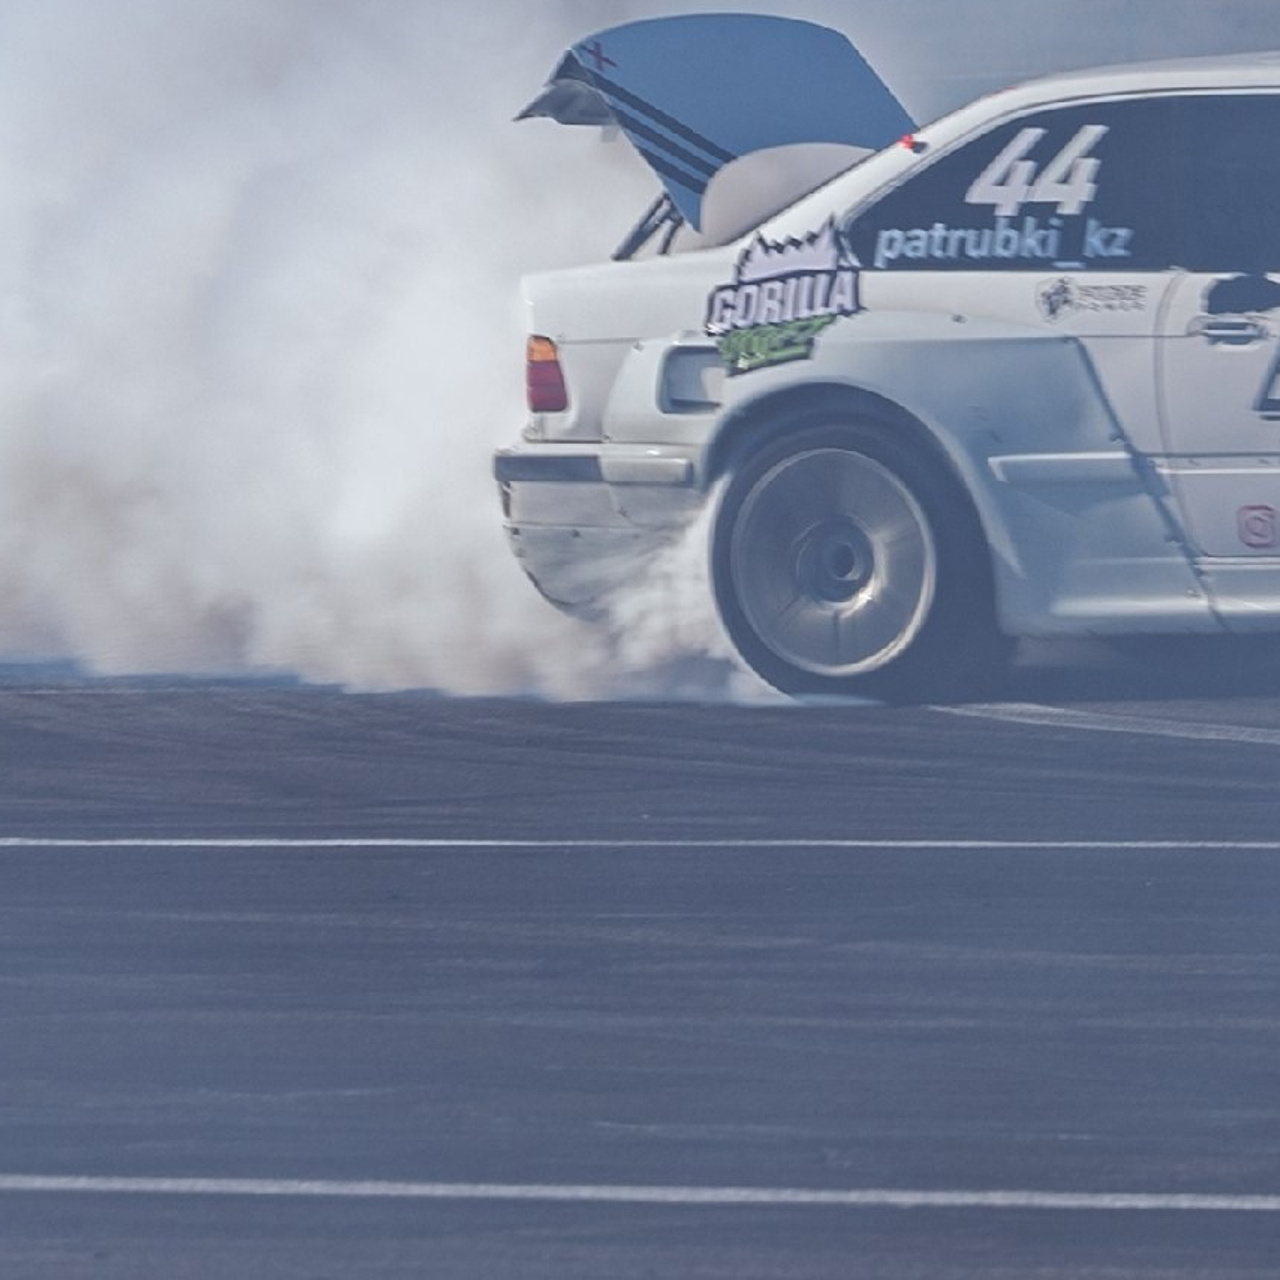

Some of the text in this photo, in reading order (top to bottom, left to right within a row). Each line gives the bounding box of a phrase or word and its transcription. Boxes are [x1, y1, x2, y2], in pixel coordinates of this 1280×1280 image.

[964, 124, 1109, 216] 44
[873, 216, 1134, 269] patrubki_kz
[709, 269, 859, 332] GORILLA
